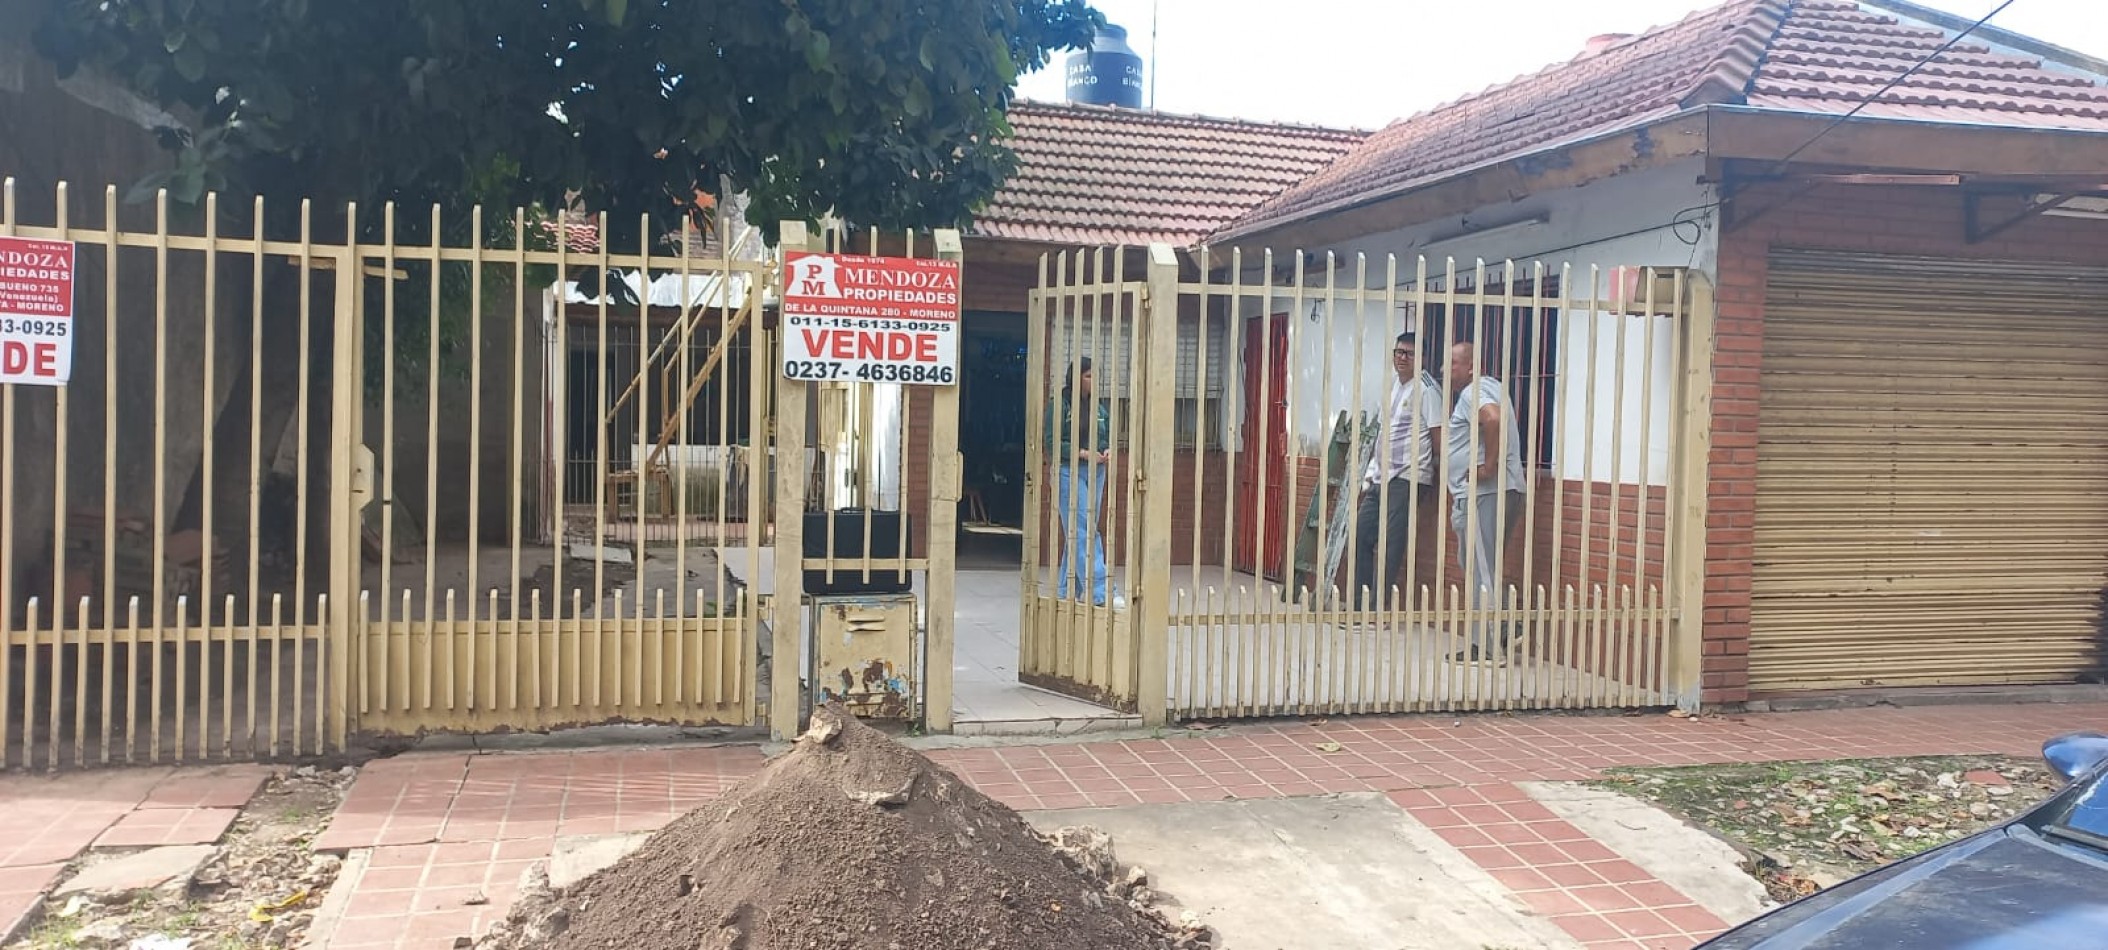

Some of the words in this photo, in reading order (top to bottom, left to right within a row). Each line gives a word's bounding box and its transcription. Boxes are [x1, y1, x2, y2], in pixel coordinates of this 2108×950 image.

[807, 264, 822, 279] P
[844, 268, 956, 289] MENDOZA
[801, 280, 826, 296] M
[843, 287, 956, 304] PROPIEDADES
[17, 302, 64, 312] MORENO
[785, 303, 800, 312] DE
[804, 304, 817, 313] LA
[820, 305, 878, 316] QUINTANA
[881, 307, 900, 316] 280
[910, 309, 956, 319] MORENO
[0, 318, 66, 337] 3-0925
[790, 316, 951, 332] 011-15-6133-0925
[801, 328, 938, 362] VENDE
[785, 360, 849, 379] 0237-
[856, 362, 953, 383] 4636846
